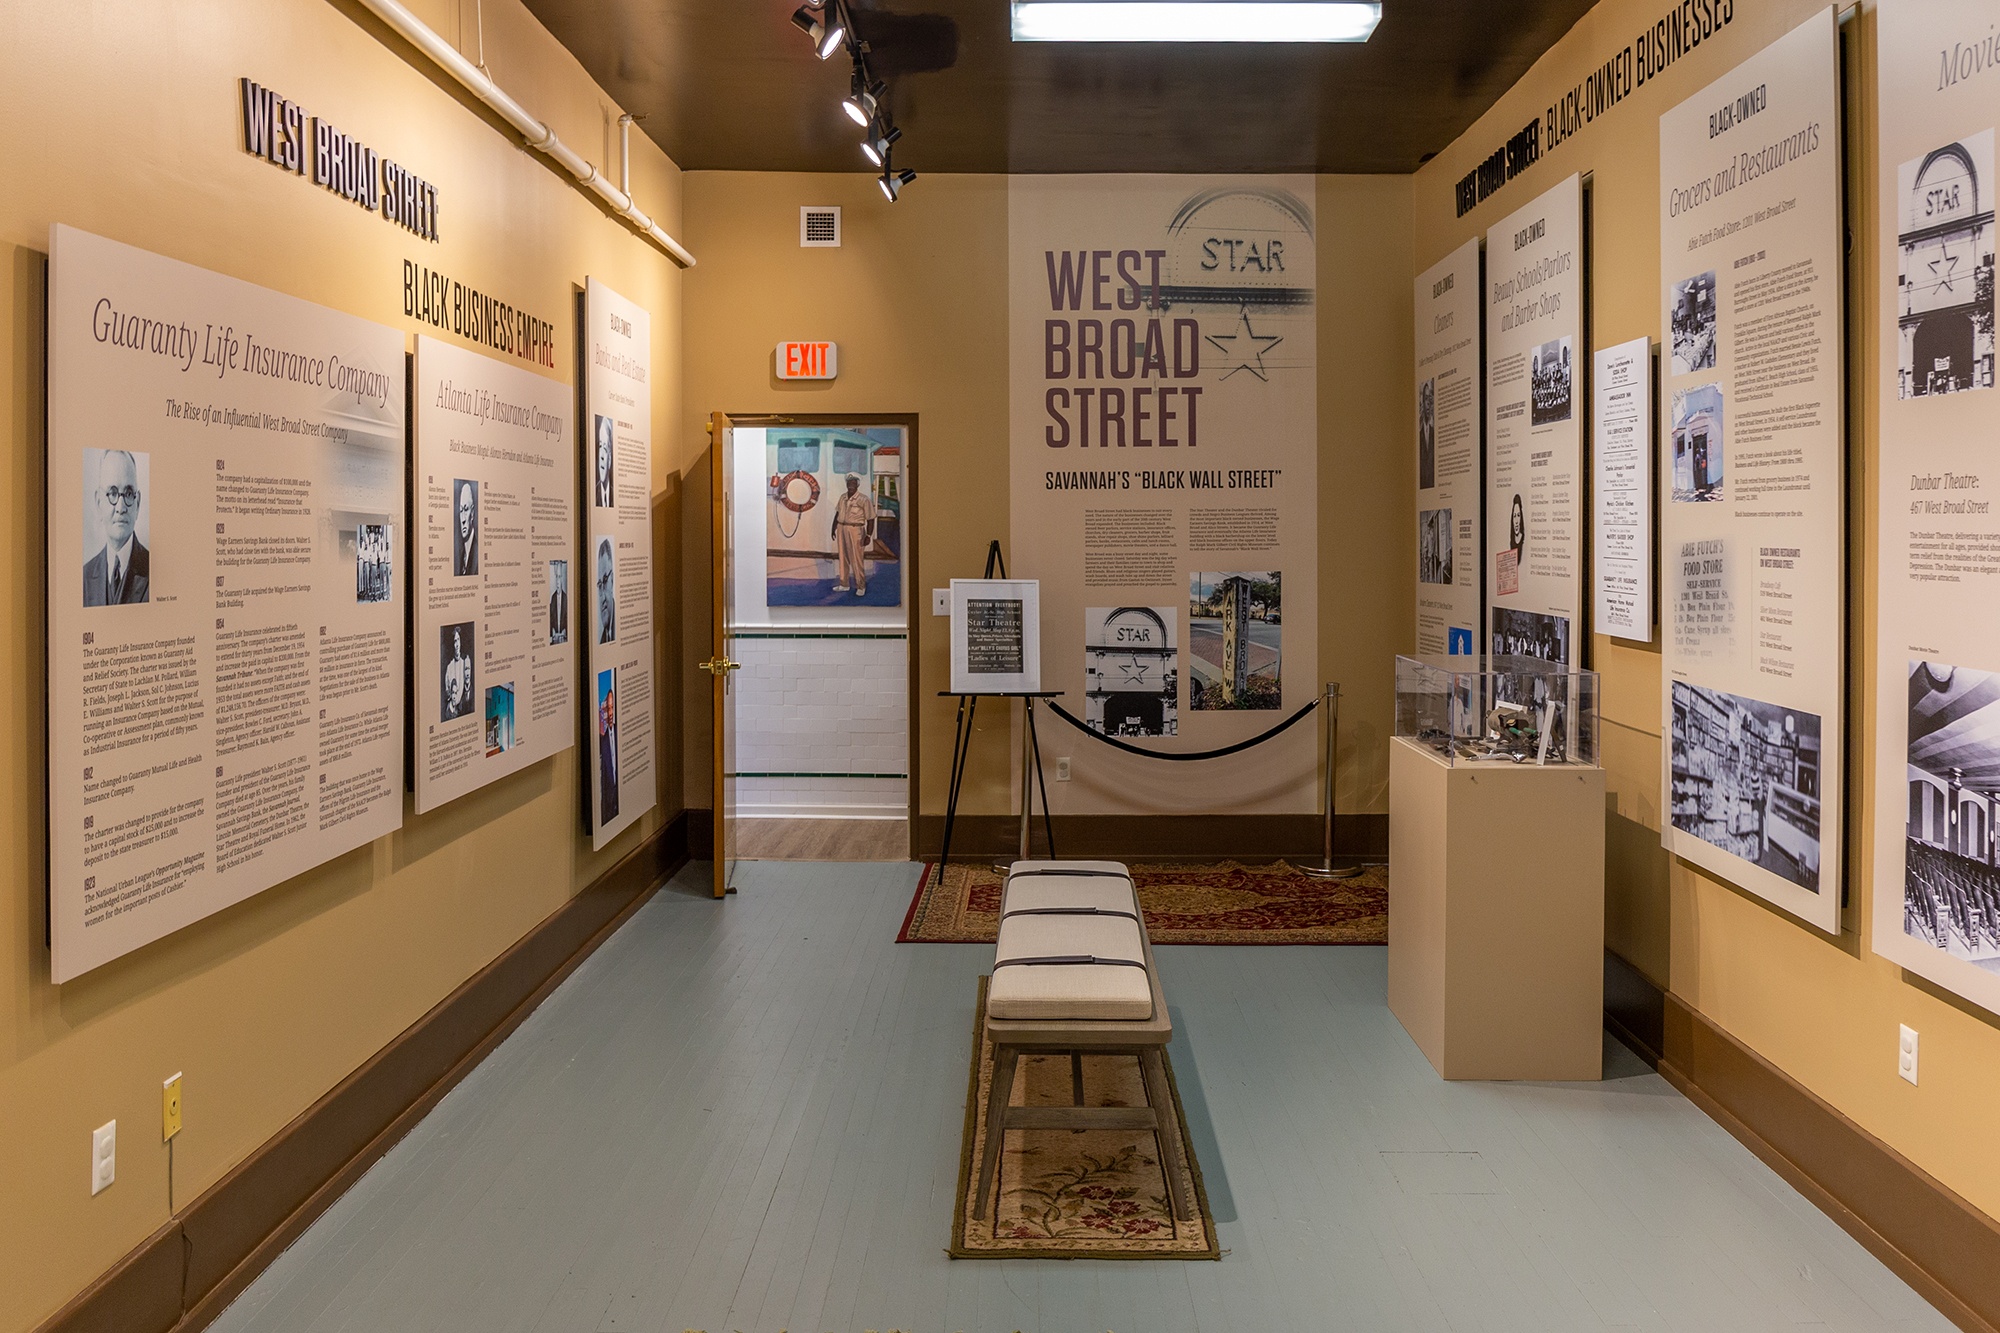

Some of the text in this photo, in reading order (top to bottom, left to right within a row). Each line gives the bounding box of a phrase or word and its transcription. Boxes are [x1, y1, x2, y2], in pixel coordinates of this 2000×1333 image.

[1710, 84, 1767, 140] BLACK-OWNED
[1455, 170, 1477, 219] WEST
[1477, 146, 1506, 203] BROAD
[1547, 46, 1632, 152] BLACK-OWNED
[240, 77, 439, 243] WEST BROAD STREET
[1670, 122, 1820, 218] Grocers and Restaurants
[1926, 184, 1960, 216] STAR
[1714, 223, 1726, 240] Food
[1754, 211, 1766, 226] West
[1766, 202, 1781, 221] Broad
[1782, 198, 1797, 216] Street
[1514, 218, 1546, 252] BLACK-OWNED
[1201, 238, 1285, 273] STAR
[1045, 250, 1166, 311] WEST
[1494, 250, 1571, 305] Beauty Schools/Parlors
[404, 258, 555, 369] BLACK BUSINESS EMPIRE
[1434, 311, 1454, 335] Cleaners
[1502, 291, 1561, 333] and Barber Shops
[92, 298, 390, 408] Guaranty Life Insurance Company
[596, 342, 611, 370] Banks
[612, 352, 621, 373] and
[786, 343, 830, 377] EXIT
[1045, 318, 1200, 380] BROAD
[166, 399, 349, 445] The Rise of an Influential West Broad Street Company
[436, 380, 563, 442] Atlanta Life Insurance Company
[1045, 387, 1203, 449] STREET
[461, 440, 477, 455] Business
[1046, 471, 1130, 490] SAVANNAH'S
[1190, 470, 1224, 489] WALL
[1910, 472, 1980, 491] Dunbar Theatre:
[1910, 499, 1990, 515] 467 West Broad Street
[1910, 542, 1940, 550] entertainment
[1967, 544, 1989, 553] provided
[1955, 532, 1979, 542] delivering
[1684, 559, 1724, 576] FOOD STORE
[1920, 552, 1933, 560] relief
[1933, 552, 1944, 560] from
[1953, 553, 1972, 561] realities
[1972, 554, 1979, 562] of
[1978, 554, 1986, 562] the
[1935, 563, 1943, 571] The
[1980, 566, 1998, 575] elegant
[1687, 579, 1722, 589] SELF-SERVICE
[1920, 573, 1937, 582] popular
[968, 618, 1021, 627] Star Theatre
[1117, 628, 1151, 643] STAR
[83, 632, 94, 645] 1904
[83, 636, 195, 657] The Guaranty Life Insurance Company founded
[83, 661, 98, 670] under
[100, 659, 108, 667] the
[110, 655, 139, 667] Corporation
[140, 654, 156, 662] known
[164, 649, 184, 658] Guaranty
[83, 673, 93, 682] and
[95, 671, 109, 680] Relief
[110, 669, 129, 678] Society.
[130, 667, 139, 675] The
[140, 665, 157, 674] charter
[168, 660, 182, 670] issued
[183, 660, 188, 669] by
[84, 784, 99, 793] Name
[100, 775, 122, 789] changed
[129, 769, 151, 781] Guaranty
[152, 762, 168, 775] Mutual
[170, 761, 178, 770] Life
[179, 758, 187, 767] and
[188, 753, 202, 765] Health
[84, 787, 134, 805] Insurance Company.
[84, 876, 96, 891] 1923
